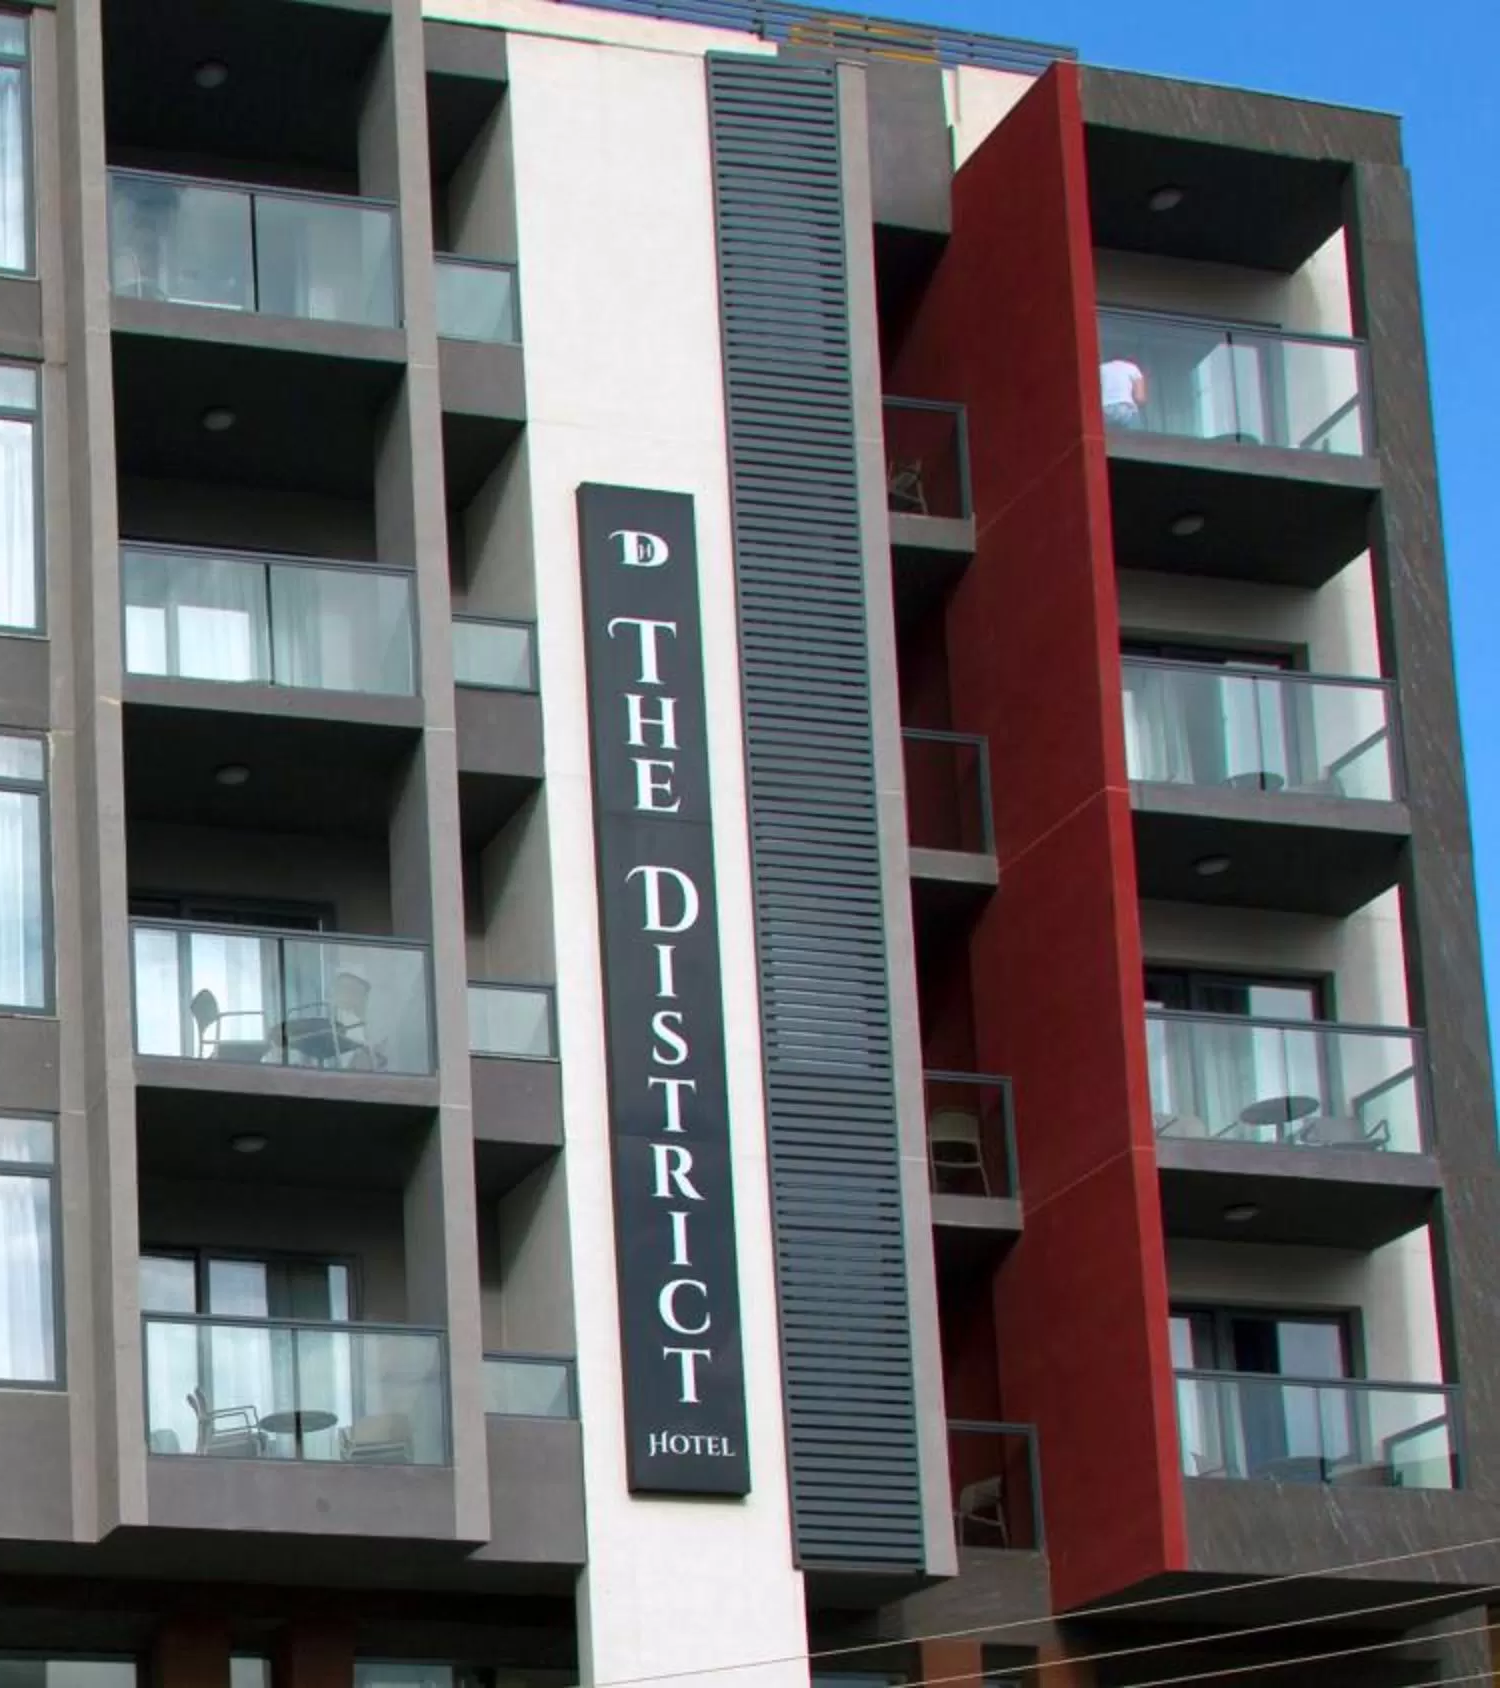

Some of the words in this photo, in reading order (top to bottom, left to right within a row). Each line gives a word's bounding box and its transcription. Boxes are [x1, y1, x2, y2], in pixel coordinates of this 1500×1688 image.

[607, 616, 680, 813] THE
[625, 865, 712, 1404] DISTRICT
[649, 1431, 736, 1457] HOTEL
